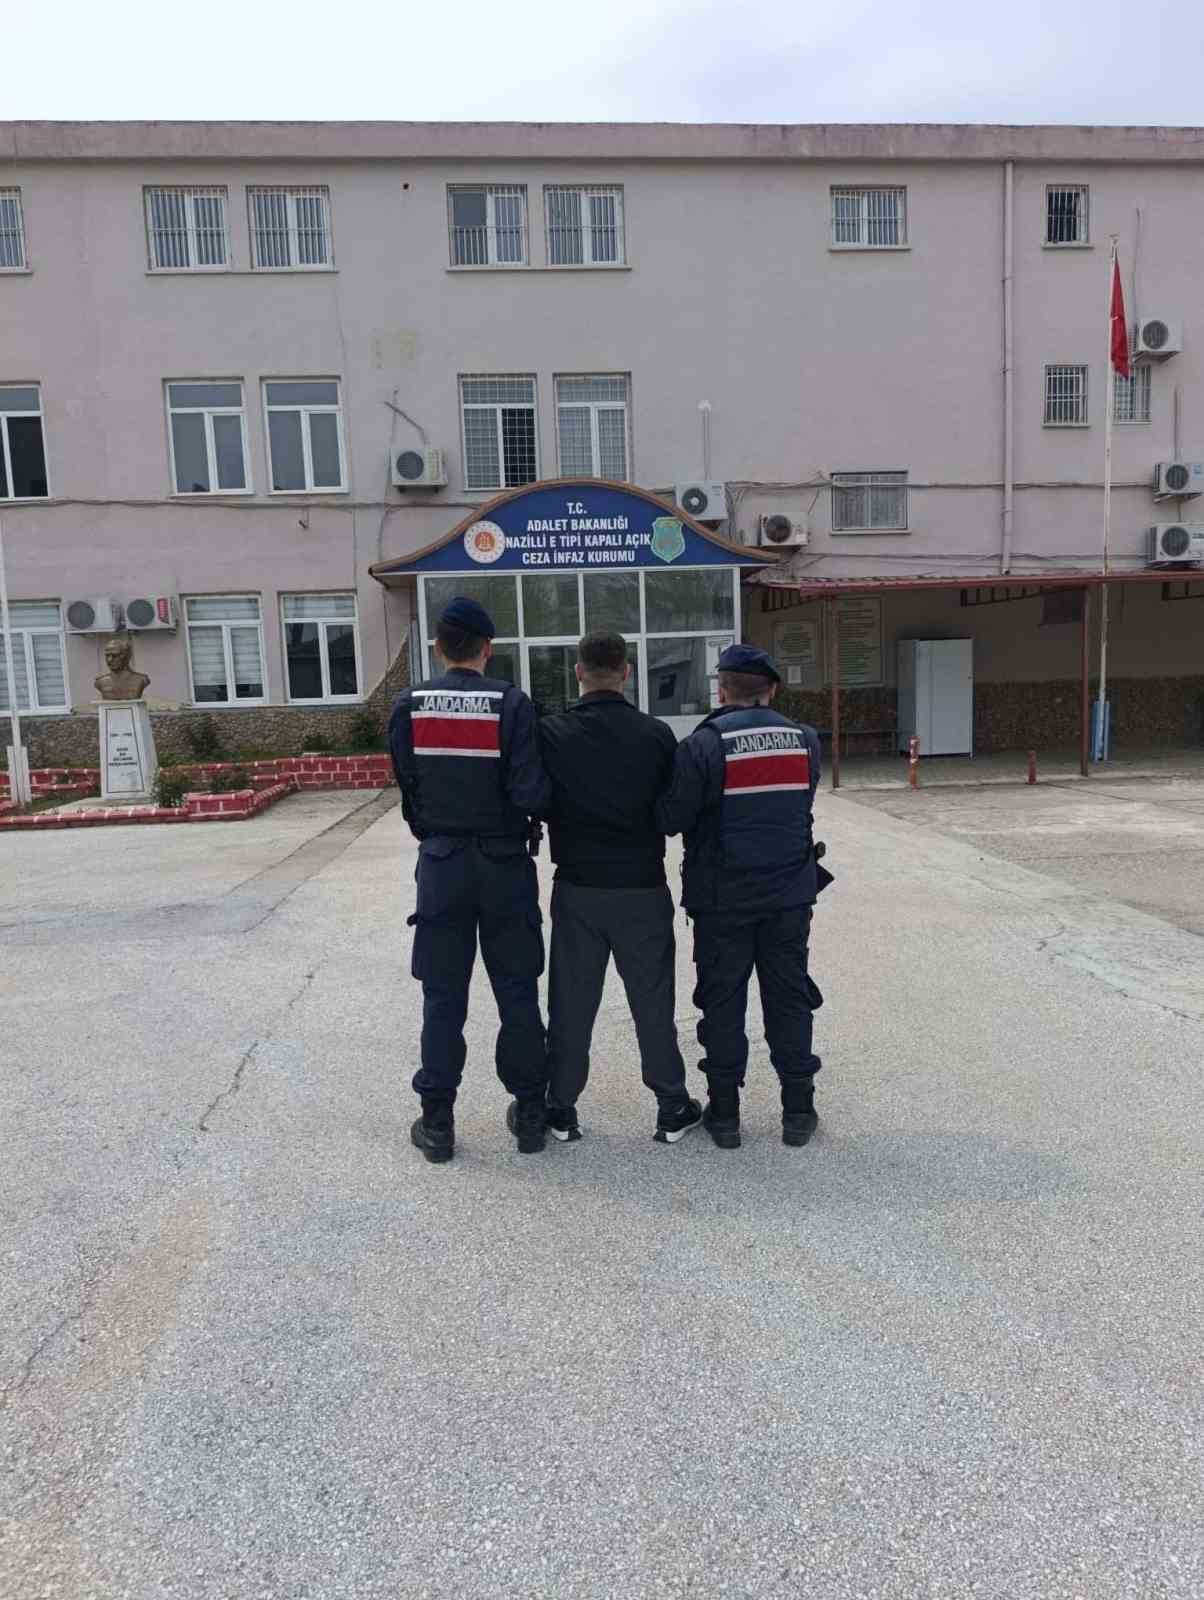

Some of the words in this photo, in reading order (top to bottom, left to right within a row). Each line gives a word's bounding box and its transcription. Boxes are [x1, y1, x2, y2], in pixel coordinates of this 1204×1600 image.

[567, 502, 587, 514] T.C.
[527, 519, 569, 532] ADALET
[571, 515, 628, 530] BAKANLIĞI
[505, 533, 547, 549] NAZİLLİ
[550, 536, 557, 548] E
[584, 534, 622, 547] KAPALI
[625, 533, 651, 549] AÇIK
[522, 552, 550, 564] CEZA
[553, 549, 585, 564] İNFAZ
[587, 550, 636, 563] KURUMU
[419, 695, 492, 713] JANDARMA
[733, 732, 801, 753] JANDARMA
